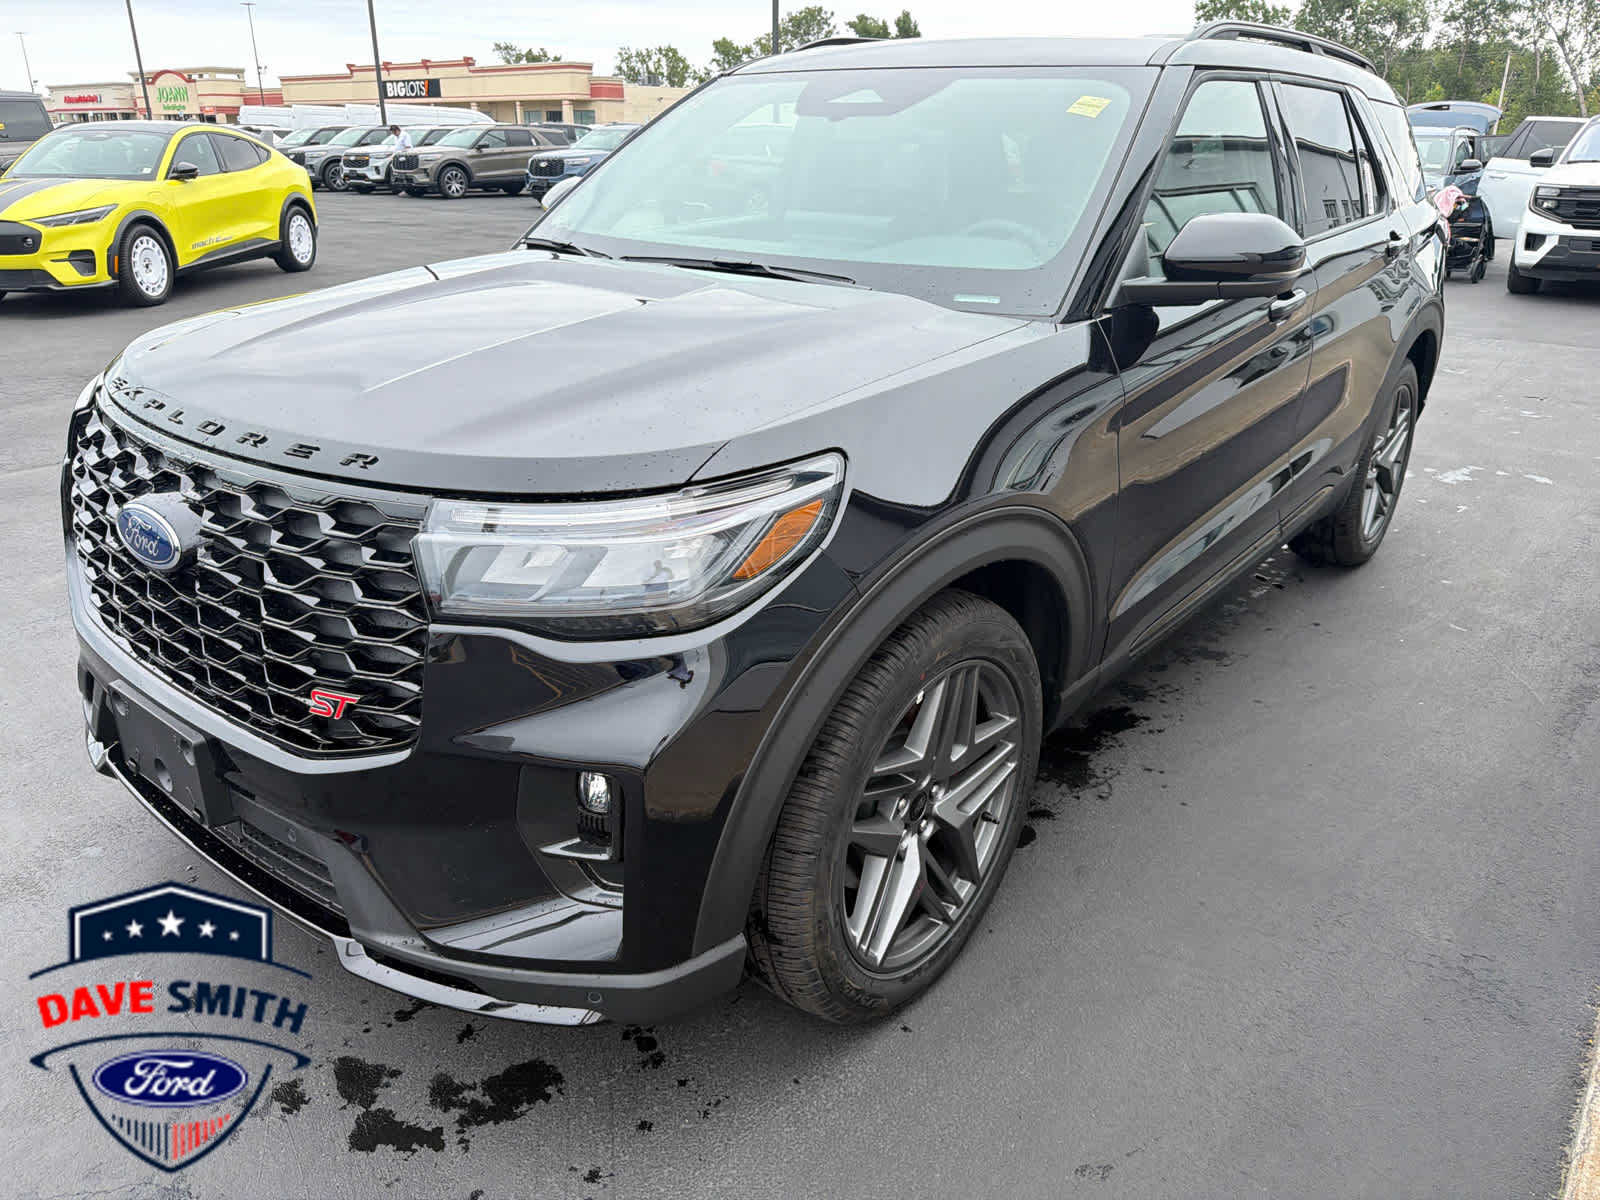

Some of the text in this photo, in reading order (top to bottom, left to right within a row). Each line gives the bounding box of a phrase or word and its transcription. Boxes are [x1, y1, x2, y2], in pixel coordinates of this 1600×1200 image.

[157, 87, 189, 102] JOANN
[113, 377, 379, 470] EXPLORER
[125, 515, 159, 556] Ford
[309, 689, 358, 720] ST
